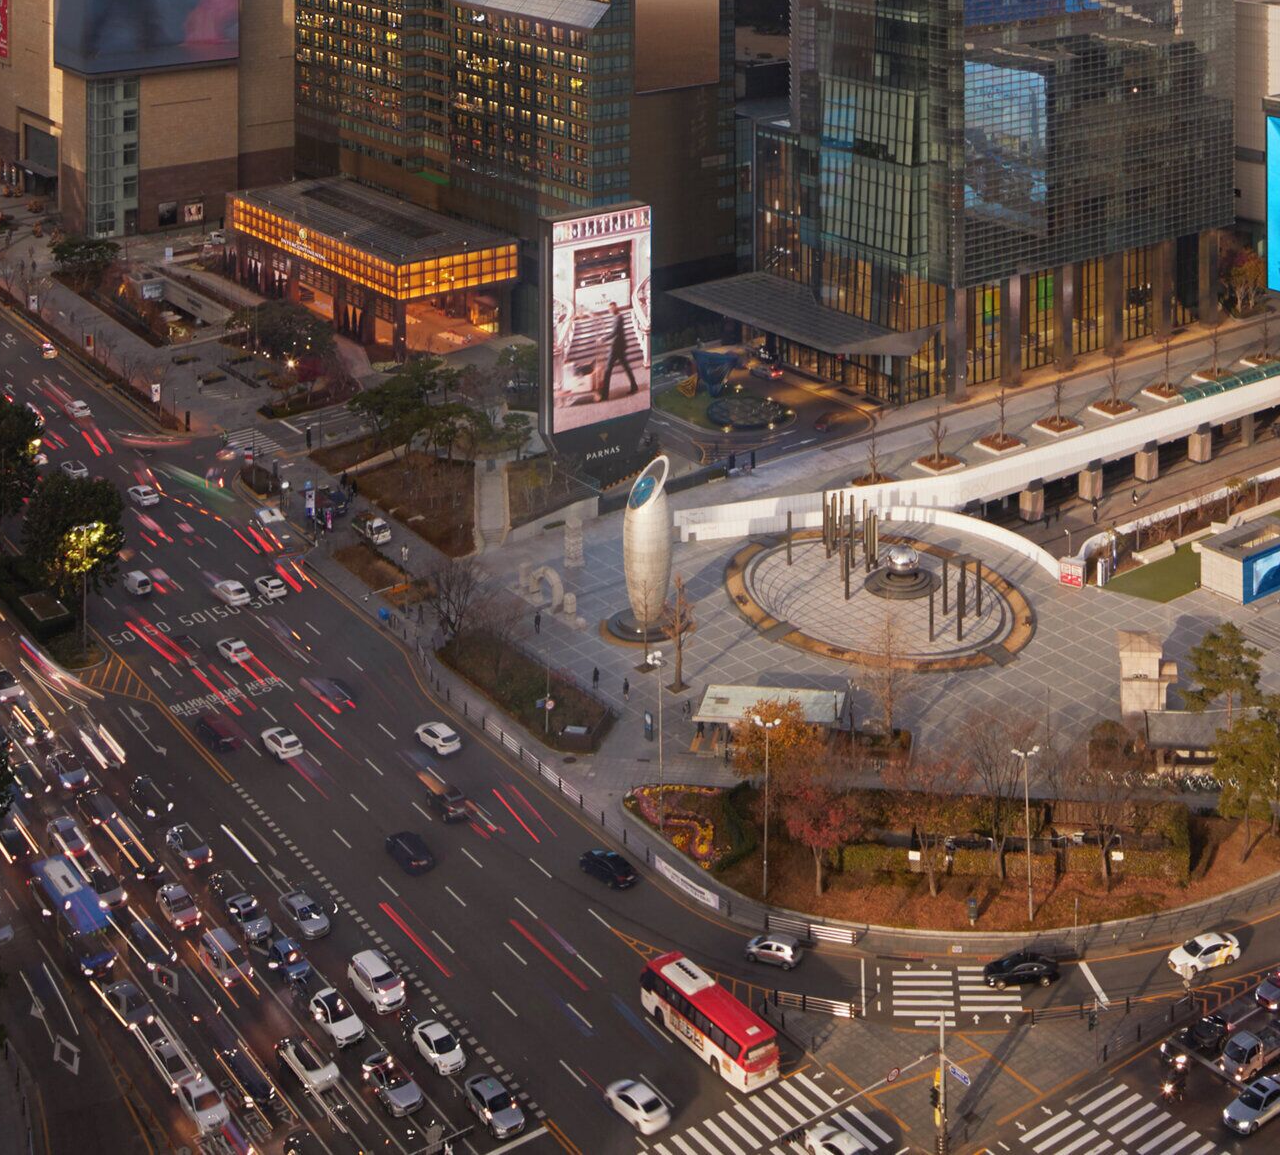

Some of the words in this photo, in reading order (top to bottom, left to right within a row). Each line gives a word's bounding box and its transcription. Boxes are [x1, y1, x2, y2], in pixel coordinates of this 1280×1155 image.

[586, 444, 621, 461] PARNAS
[178, 611, 206, 627] 50
[107, 630, 136, 645] 50
